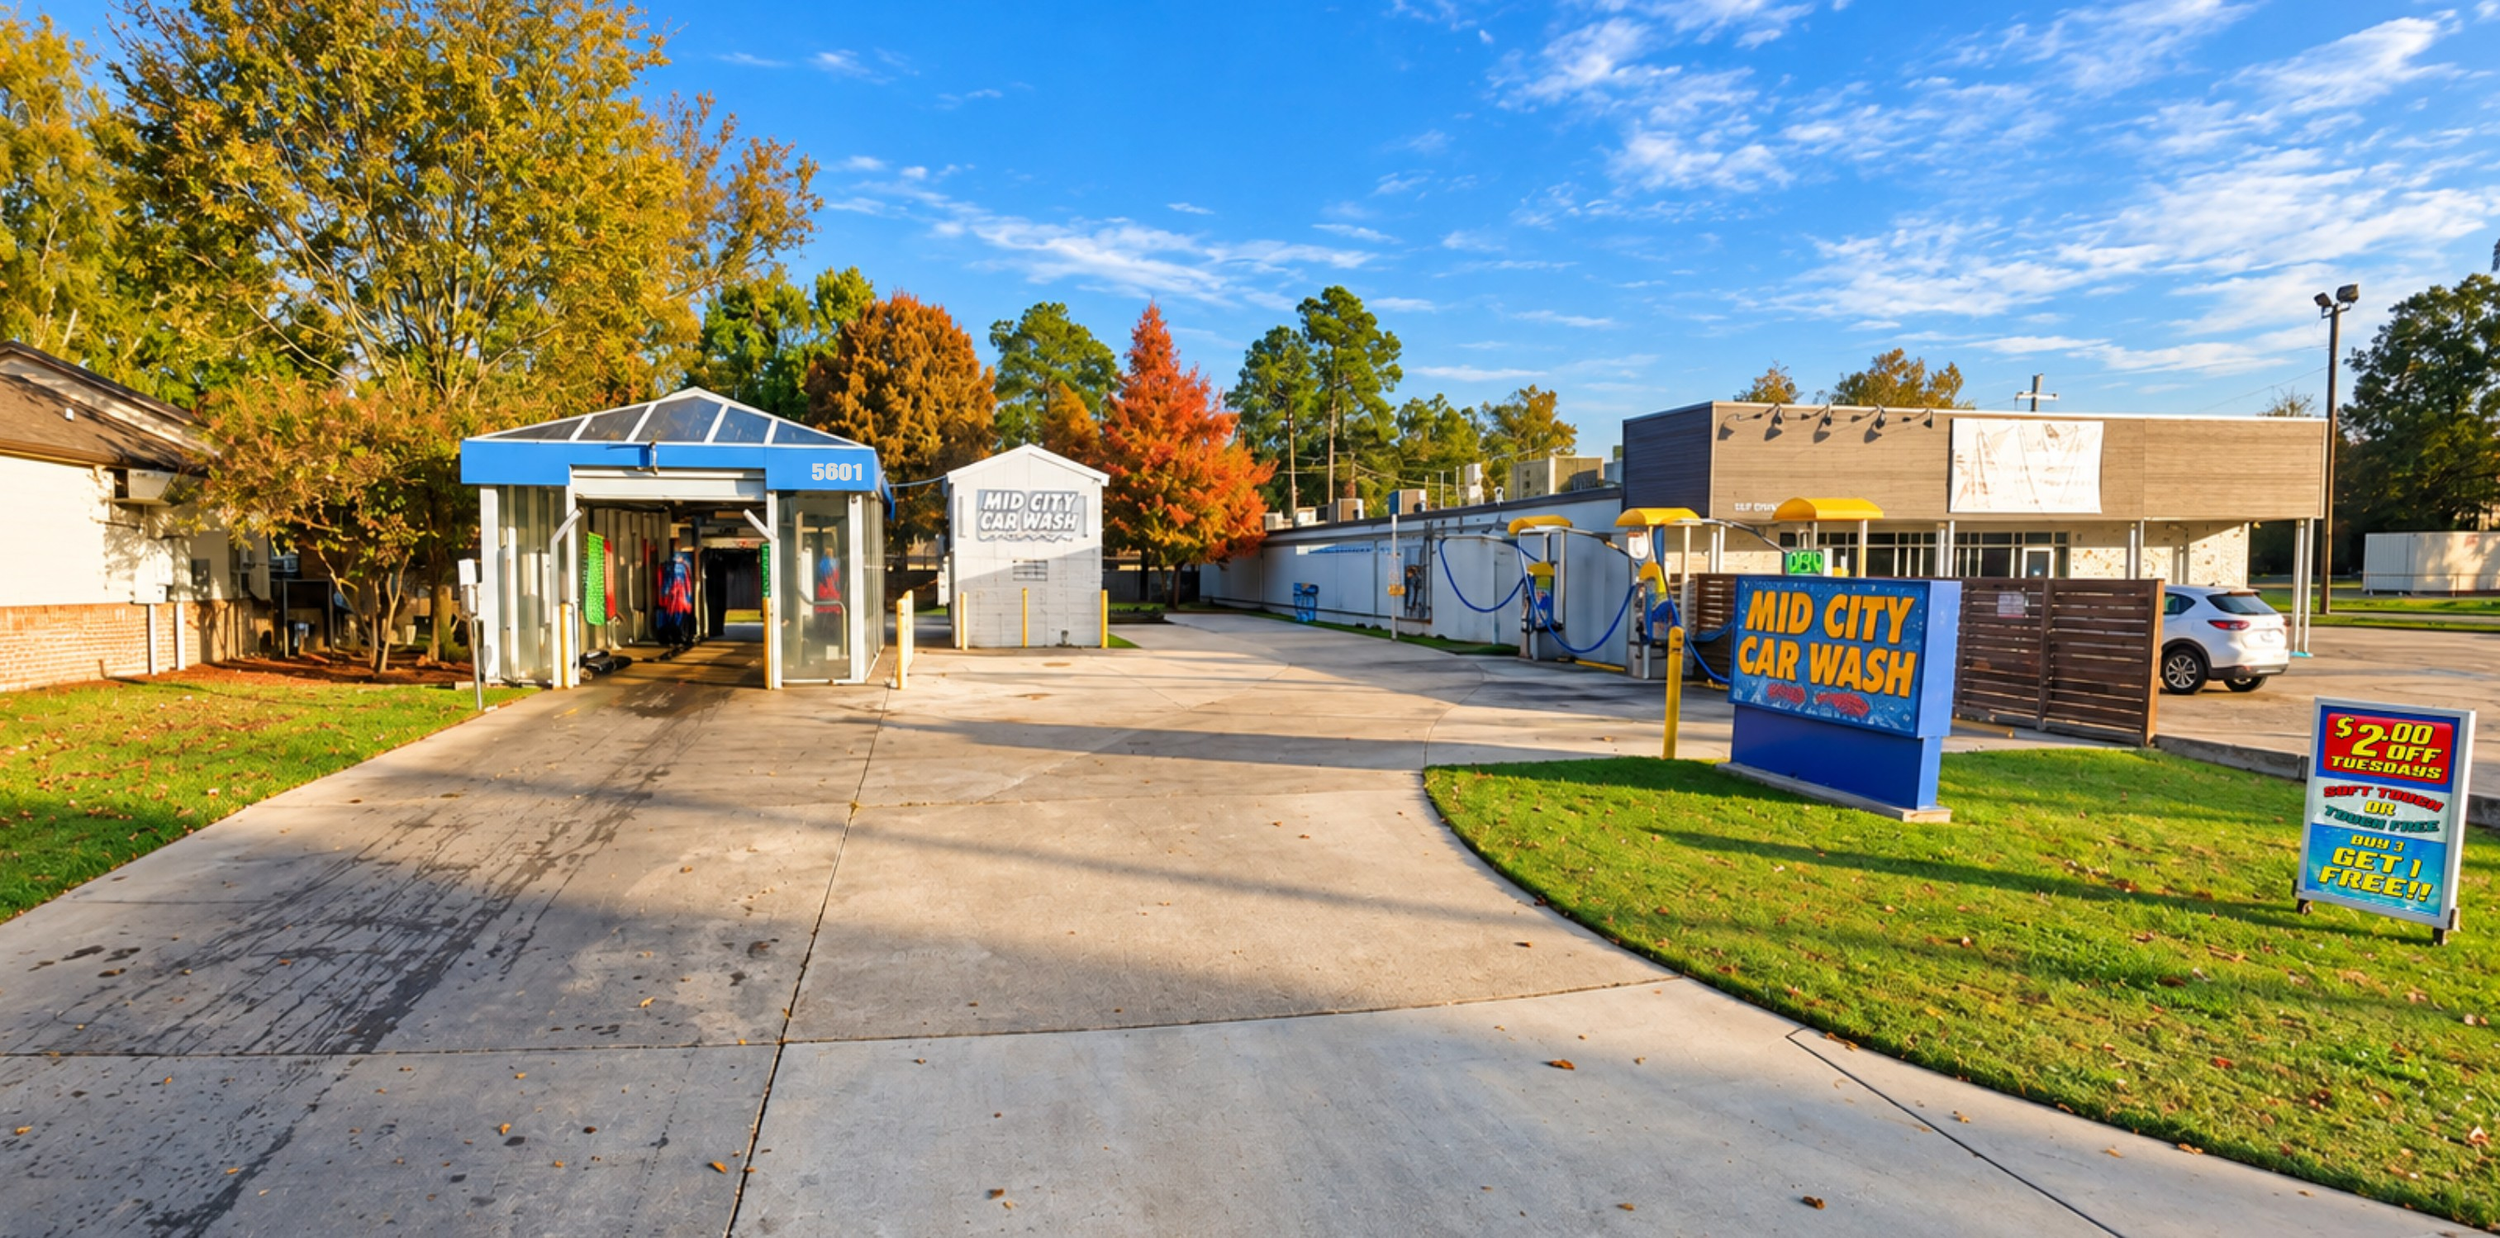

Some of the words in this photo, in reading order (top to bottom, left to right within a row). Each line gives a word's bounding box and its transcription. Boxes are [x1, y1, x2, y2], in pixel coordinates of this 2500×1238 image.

[811, 462, 863, 481] 5601
[983, 491, 1026, 511] MID
[1029, 492, 1077, 512] CITY
[979, 511, 1018, 530] CAR
[1021, 511, 1079, 530] WASH
[1744, 590, 1814, 635] MID
[1823, 593, 1916, 644] CITY
[1737, 635, 1800, 681] CAR
[1809, 642, 1917, 698] WASH
[2334, 716, 2434, 758] $2.00
[2386, 744, 2443, 764] OFF
[2330, 755, 2443, 779] TUESDAYS
[2323, 785, 2373, 798] SOFT
[2378, 787, 2444, 813] TOUCH
[2364, 800, 2396, 816] OR
[2324, 804, 2387, 829] TOUCH
[2388, 820, 2441, 833] FREE
[2350, 834, 2391, 850] BUY
[2393, 841, 2405, 852] 3
[2332, 846, 2404, 873] GET
[2409, 858, 2422, 878] 1
[2318, 866, 2434, 902] FREE!!
